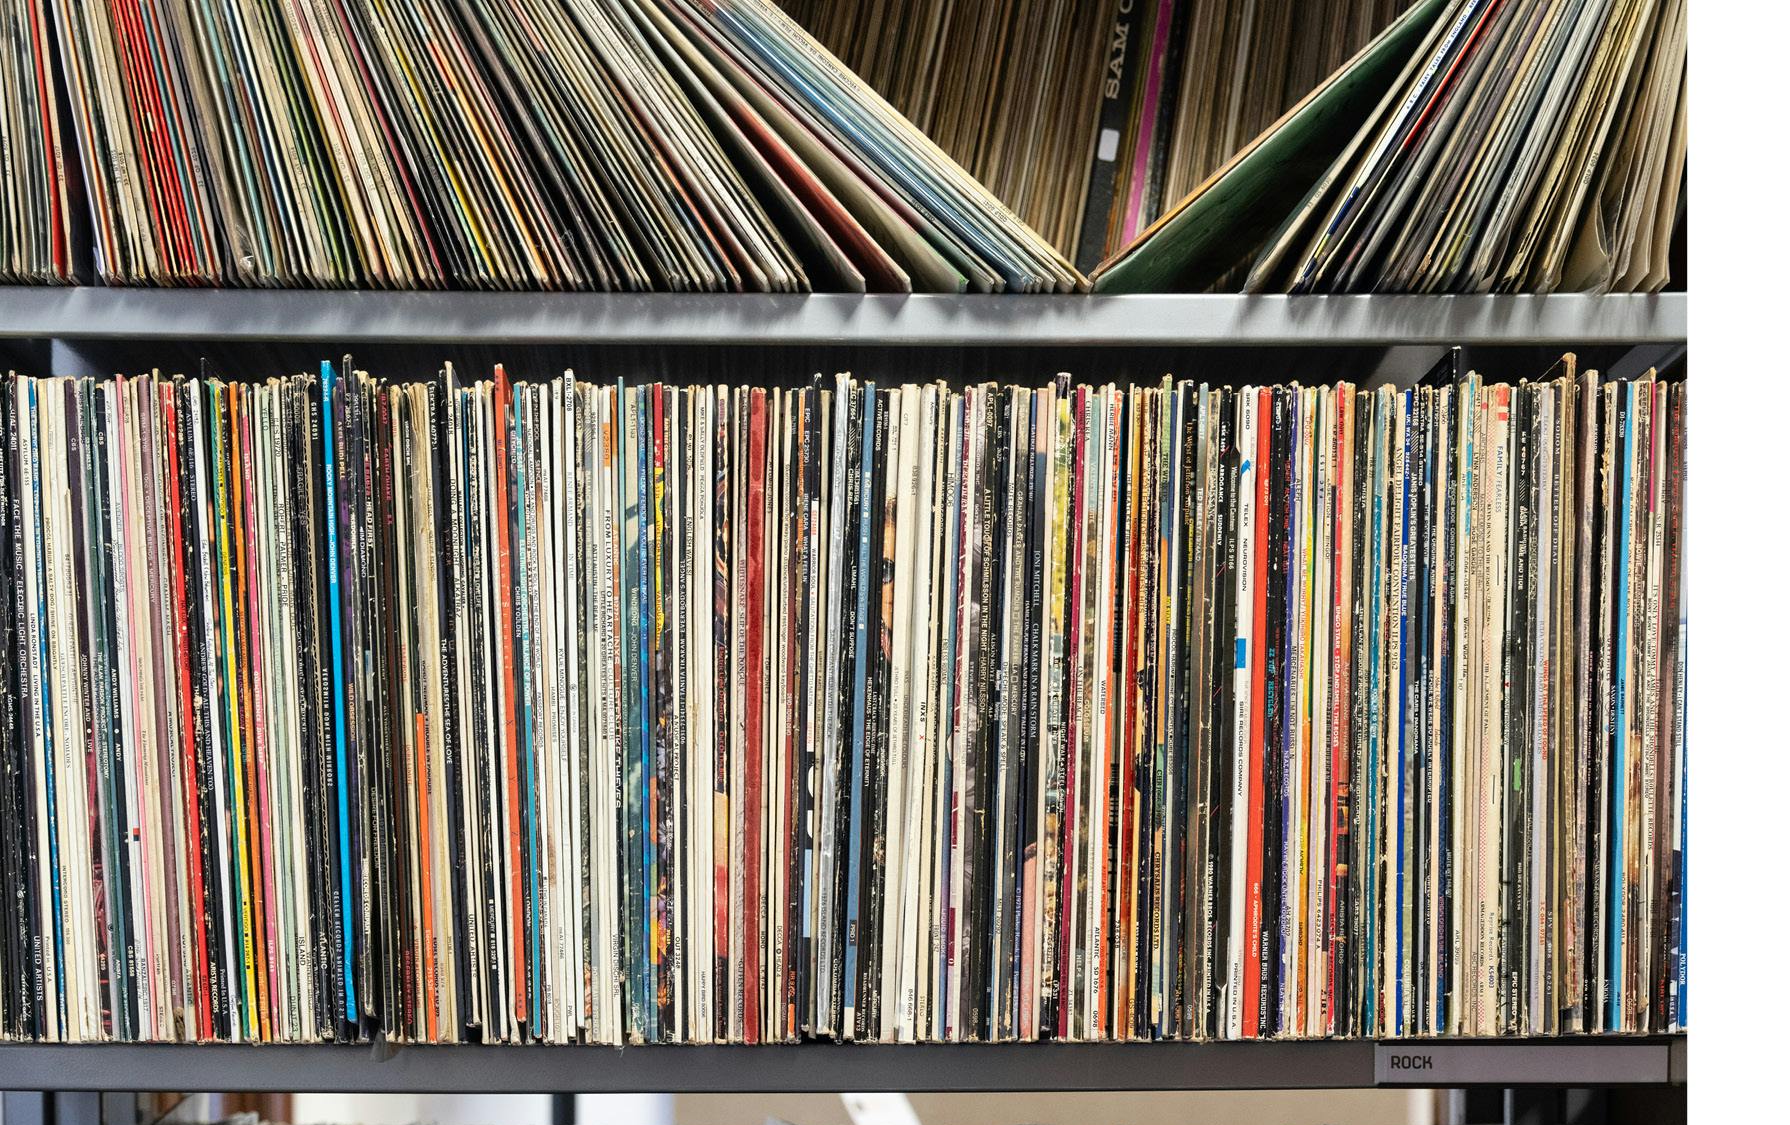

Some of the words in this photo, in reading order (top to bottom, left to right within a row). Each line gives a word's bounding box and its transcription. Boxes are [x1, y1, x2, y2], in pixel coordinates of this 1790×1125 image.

[1105, 23, 1129, 99] SAM
[1440, 40, 1451, 54] FROM
[279, 542, 287, 572] PALMER
[607, 585, 612, 597] TO
[1392, 569, 1400, 628] CONVENTION
[15, 543, 23, 569] MUSIC
[19, 650, 29, 698] ORCHESTRA
[112, 688, 120, 718] WILLIAMS
[205, 748, 213, 775] HEAVEN
[1391, 1055, 1433, 1070] ROCK
